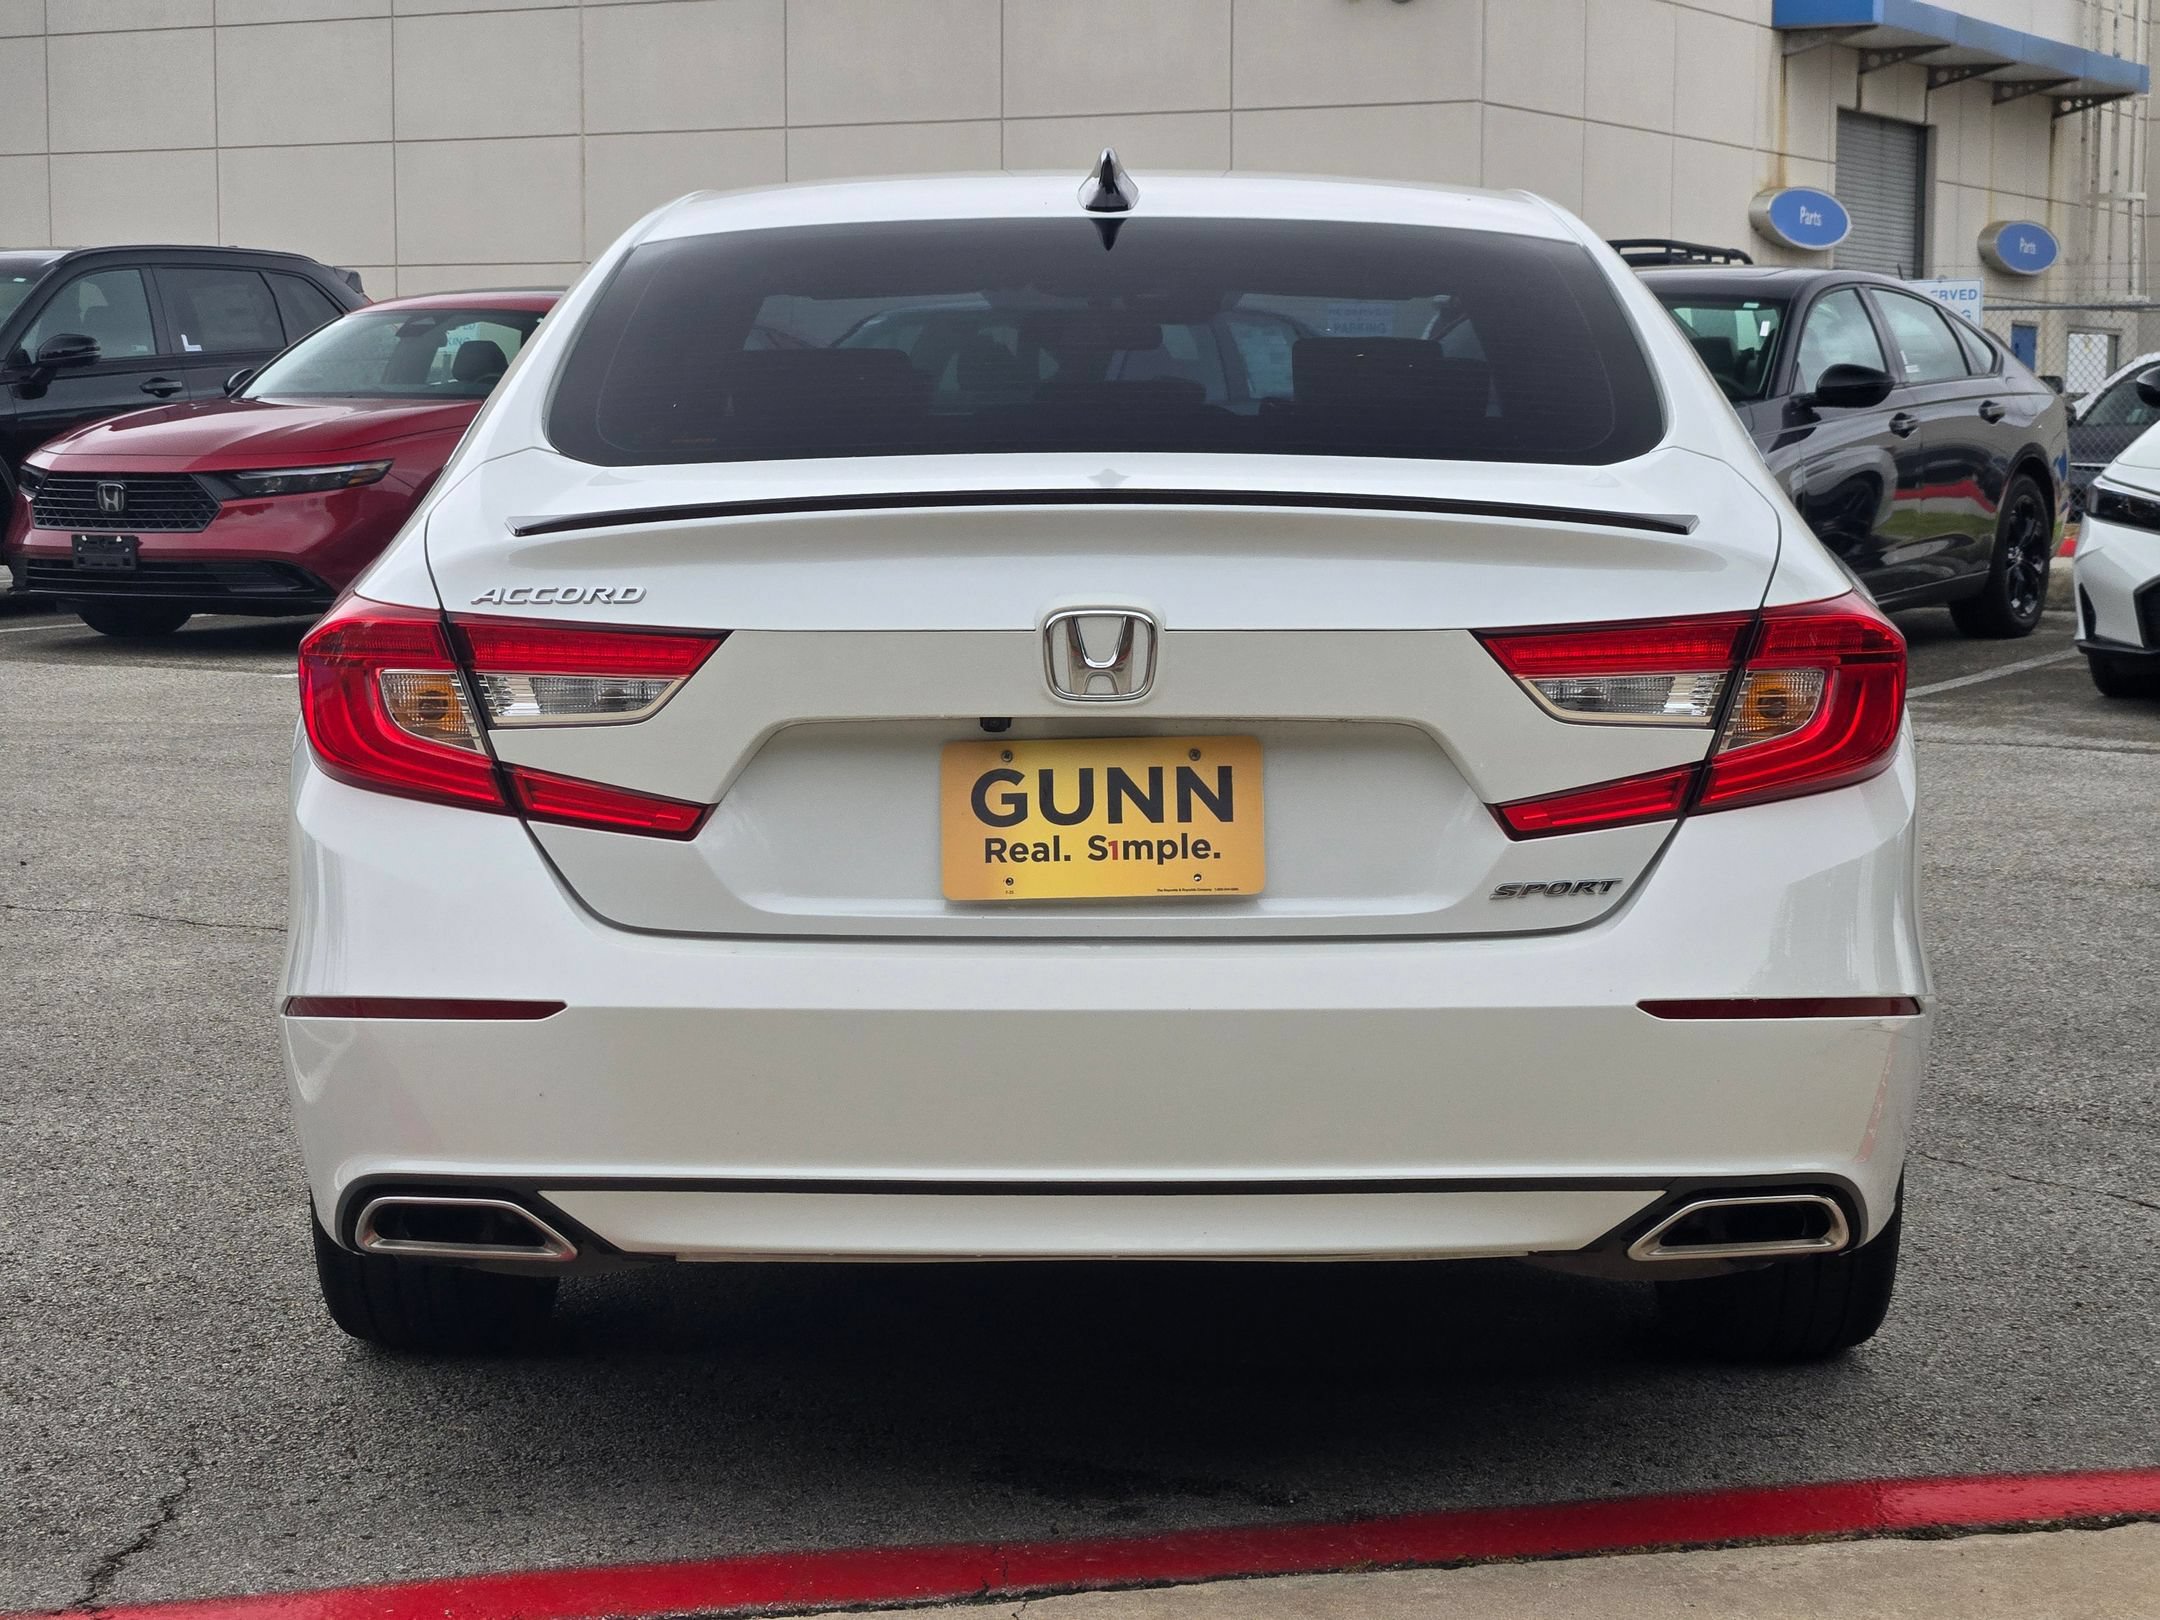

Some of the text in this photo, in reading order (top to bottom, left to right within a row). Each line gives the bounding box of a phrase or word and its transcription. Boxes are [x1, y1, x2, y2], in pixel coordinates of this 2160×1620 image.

[1800, 205, 1822, 227] Parts
[470, 585, 647, 605] ACCORD
[970, 765, 1234, 828] GUNN
[984, 834, 1071, 864] Real.
[1488, 877, 1624, 901] SPORT
